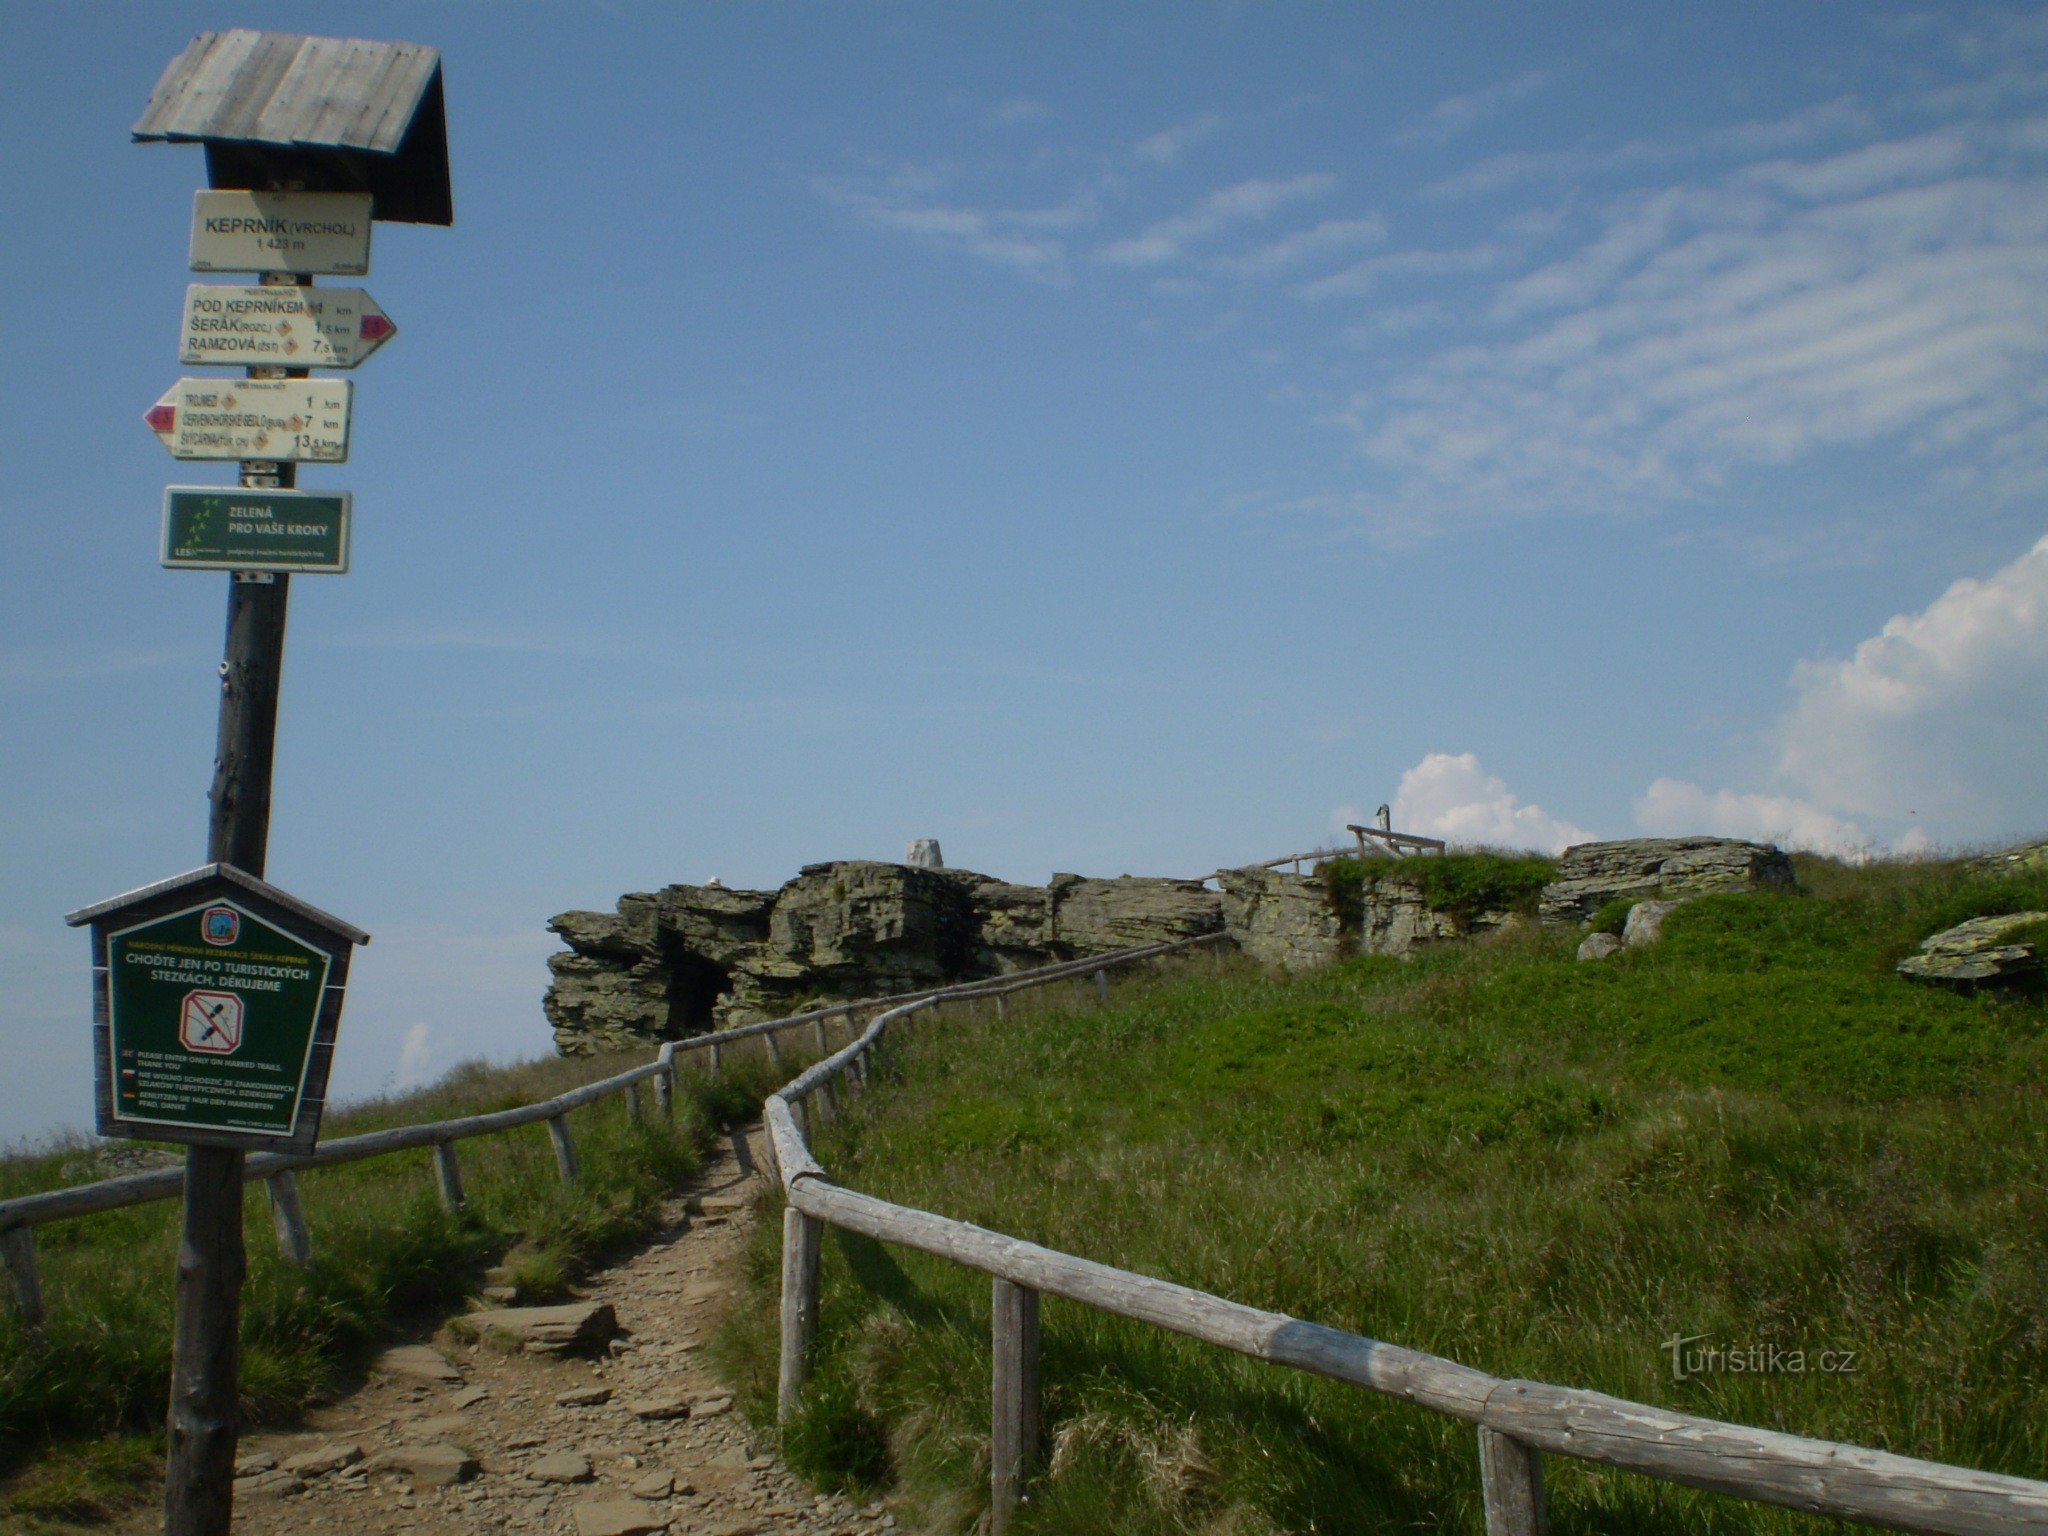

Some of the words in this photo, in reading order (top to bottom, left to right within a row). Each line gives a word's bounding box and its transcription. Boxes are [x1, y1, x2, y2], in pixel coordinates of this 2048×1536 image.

[206, 215, 287, 233] KEPRNÍK
[290, 222, 355, 237] (VRCHOL)
[292, 241, 304, 250] m
[193, 300, 221, 312] POD
[225, 299, 303, 314] KEPRNÍKEM
[337, 307, 351, 315] km
[191, 316, 239, 331] ŠERÁK
[334, 325, 350, 334] km
[189, 336, 256, 351] RAMZOVÁ
[332, 344, 348, 353] km
[325, 402, 340, 410] km
[304, 416, 313, 427] 7
[323, 420, 339, 429] km
[322, 440, 338, 448] km
[229, 506, 273, 518] ZELENÁ
[228, 523, 252, 533] PRO
[255, 522, 284, 535] VAŠE
[287, 525, 328, 536] KROKY
[125, 953, 176, 968] CHOĎTE
[178, 957, 201, 970] JEN
[204, 960, 222, 972] PO
[225, 961, 310, 980] TURISTICKÝCH
[151, 969, 215, 986] STEZKÁCH,
[218, 976, 281, 992] DĚKUJEME
[138, 1051, 163, 1061] PLEASE
[189, 1056, 209, 1065] ONLY
[210, 1058, 223, 1066] ON
[225, 1059, 255, 1069] MARKED
[138, 1060, 163, 1069] THANK
[165, 1062, 181, 1070] YOU
